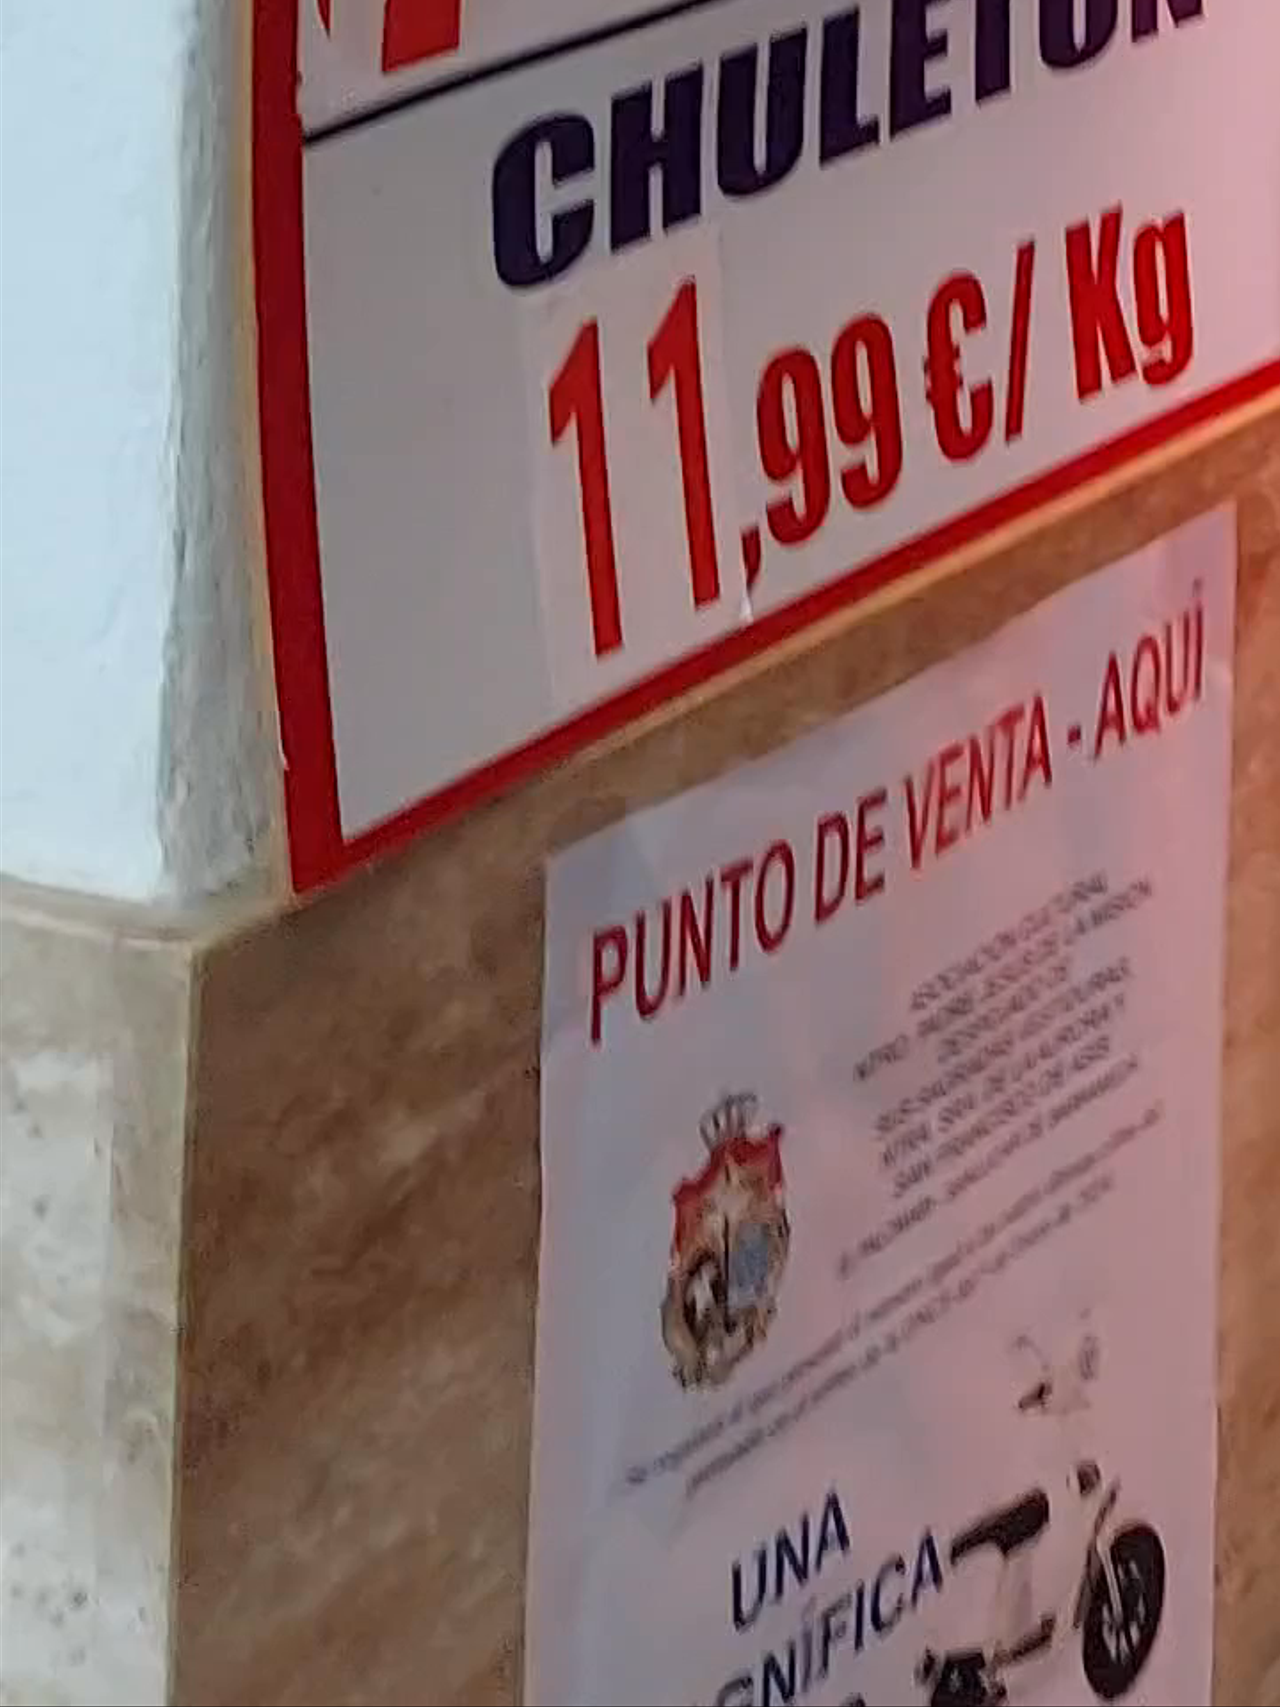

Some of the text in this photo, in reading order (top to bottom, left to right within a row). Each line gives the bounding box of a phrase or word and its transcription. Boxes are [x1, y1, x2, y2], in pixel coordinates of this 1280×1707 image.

[588, 838, 797, 1049] PUNTO
[812, 785, 889, 927] DE
[903, 694, 1054, 872] VENTA
[1095, 576, 1206, 762] AQUÍ
[731, 1488, 851, 1634] UNA
